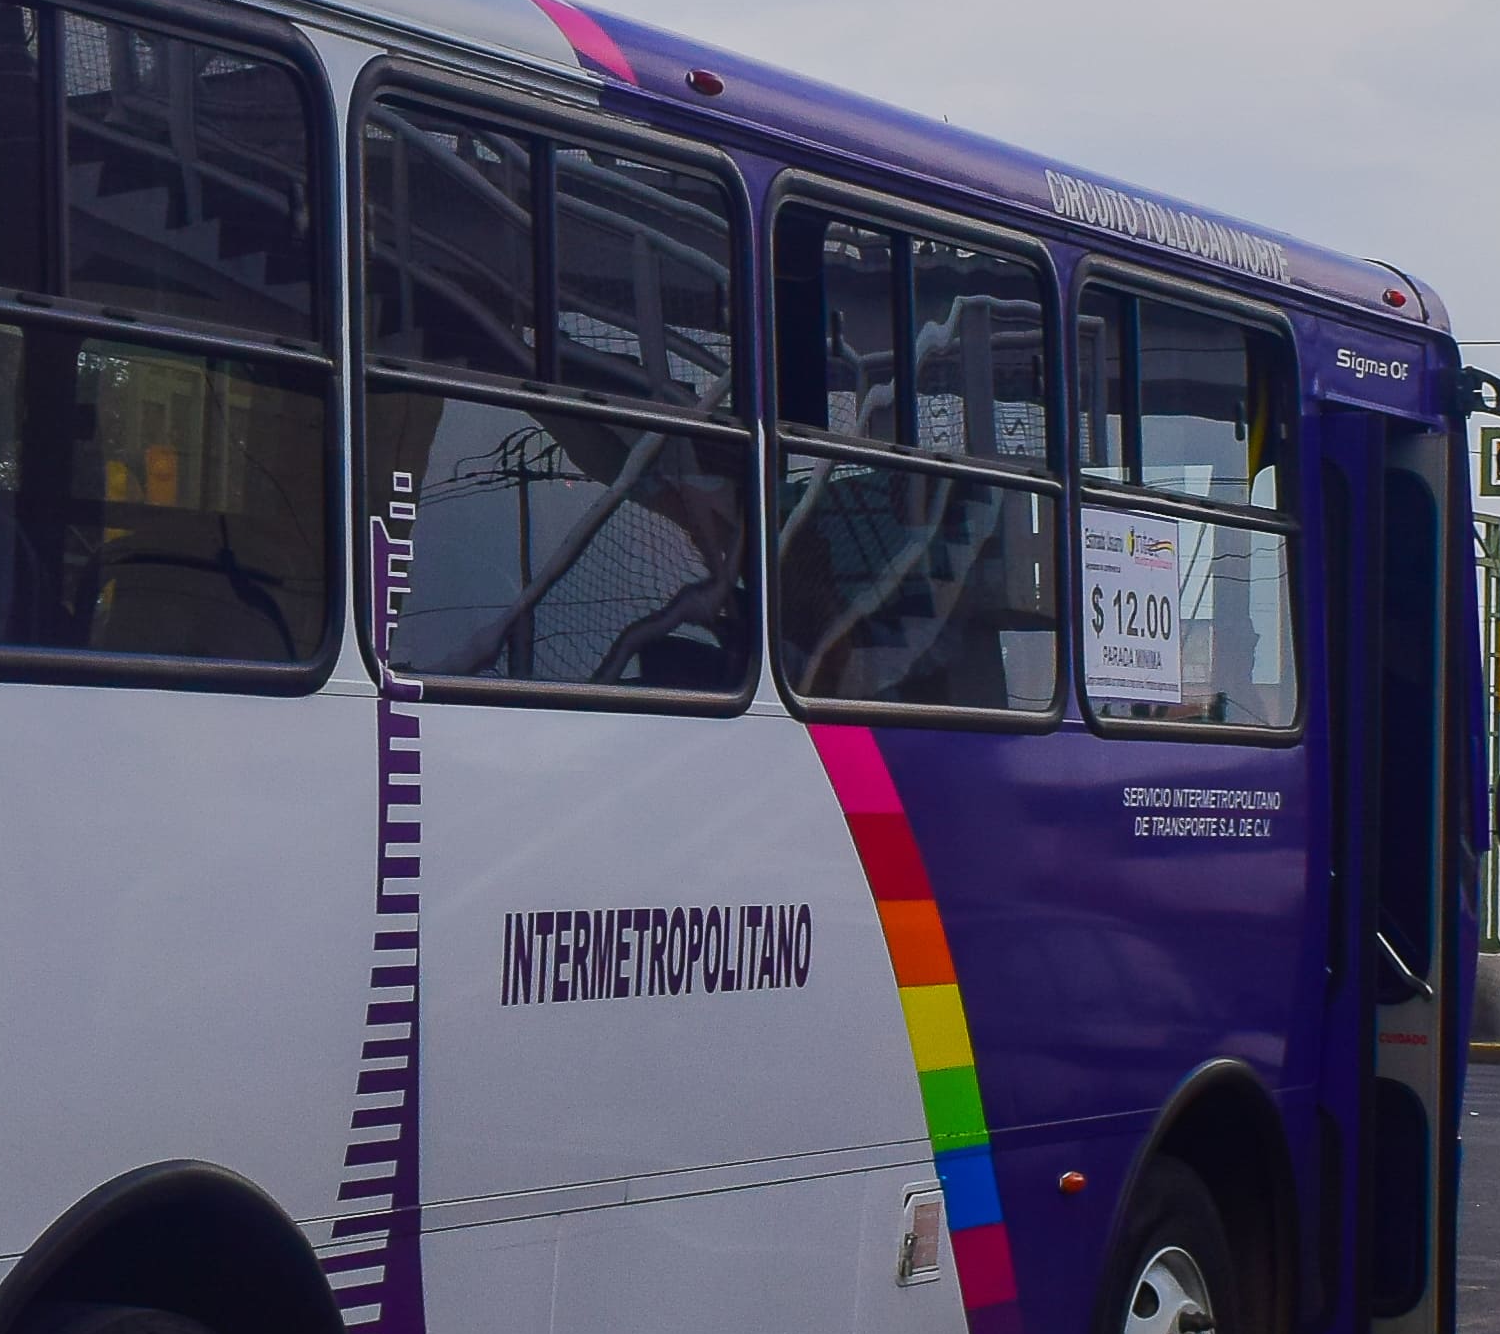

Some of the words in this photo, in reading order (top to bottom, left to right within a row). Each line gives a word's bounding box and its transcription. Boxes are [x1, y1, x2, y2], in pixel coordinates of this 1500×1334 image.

[1045, 169, 1138, 236] CIRCUITO
[1133, 198, 1236, 265] TOLLOCAN
[1230, 227, 1291, 284] NORTE
[1336, 348, 1387, 378] Sigma
[1091, 585, 1105, 638] $
[1113, 590, 1172, 640] 12.00
[1103, 646, 1134, 666] PARADA
[1123, 788, 1171, 807] SERVICIO
[1173, 789, 1281, 810] INTERMETROPOLITANO
[1135, 817, 1149, 836] DE
[1152, 817, 1217, 837] TRANSPORTE
[1239, 818, 1252, 837] DE
[501, 902, 813, 1007] INTERMETROPOLITANO
